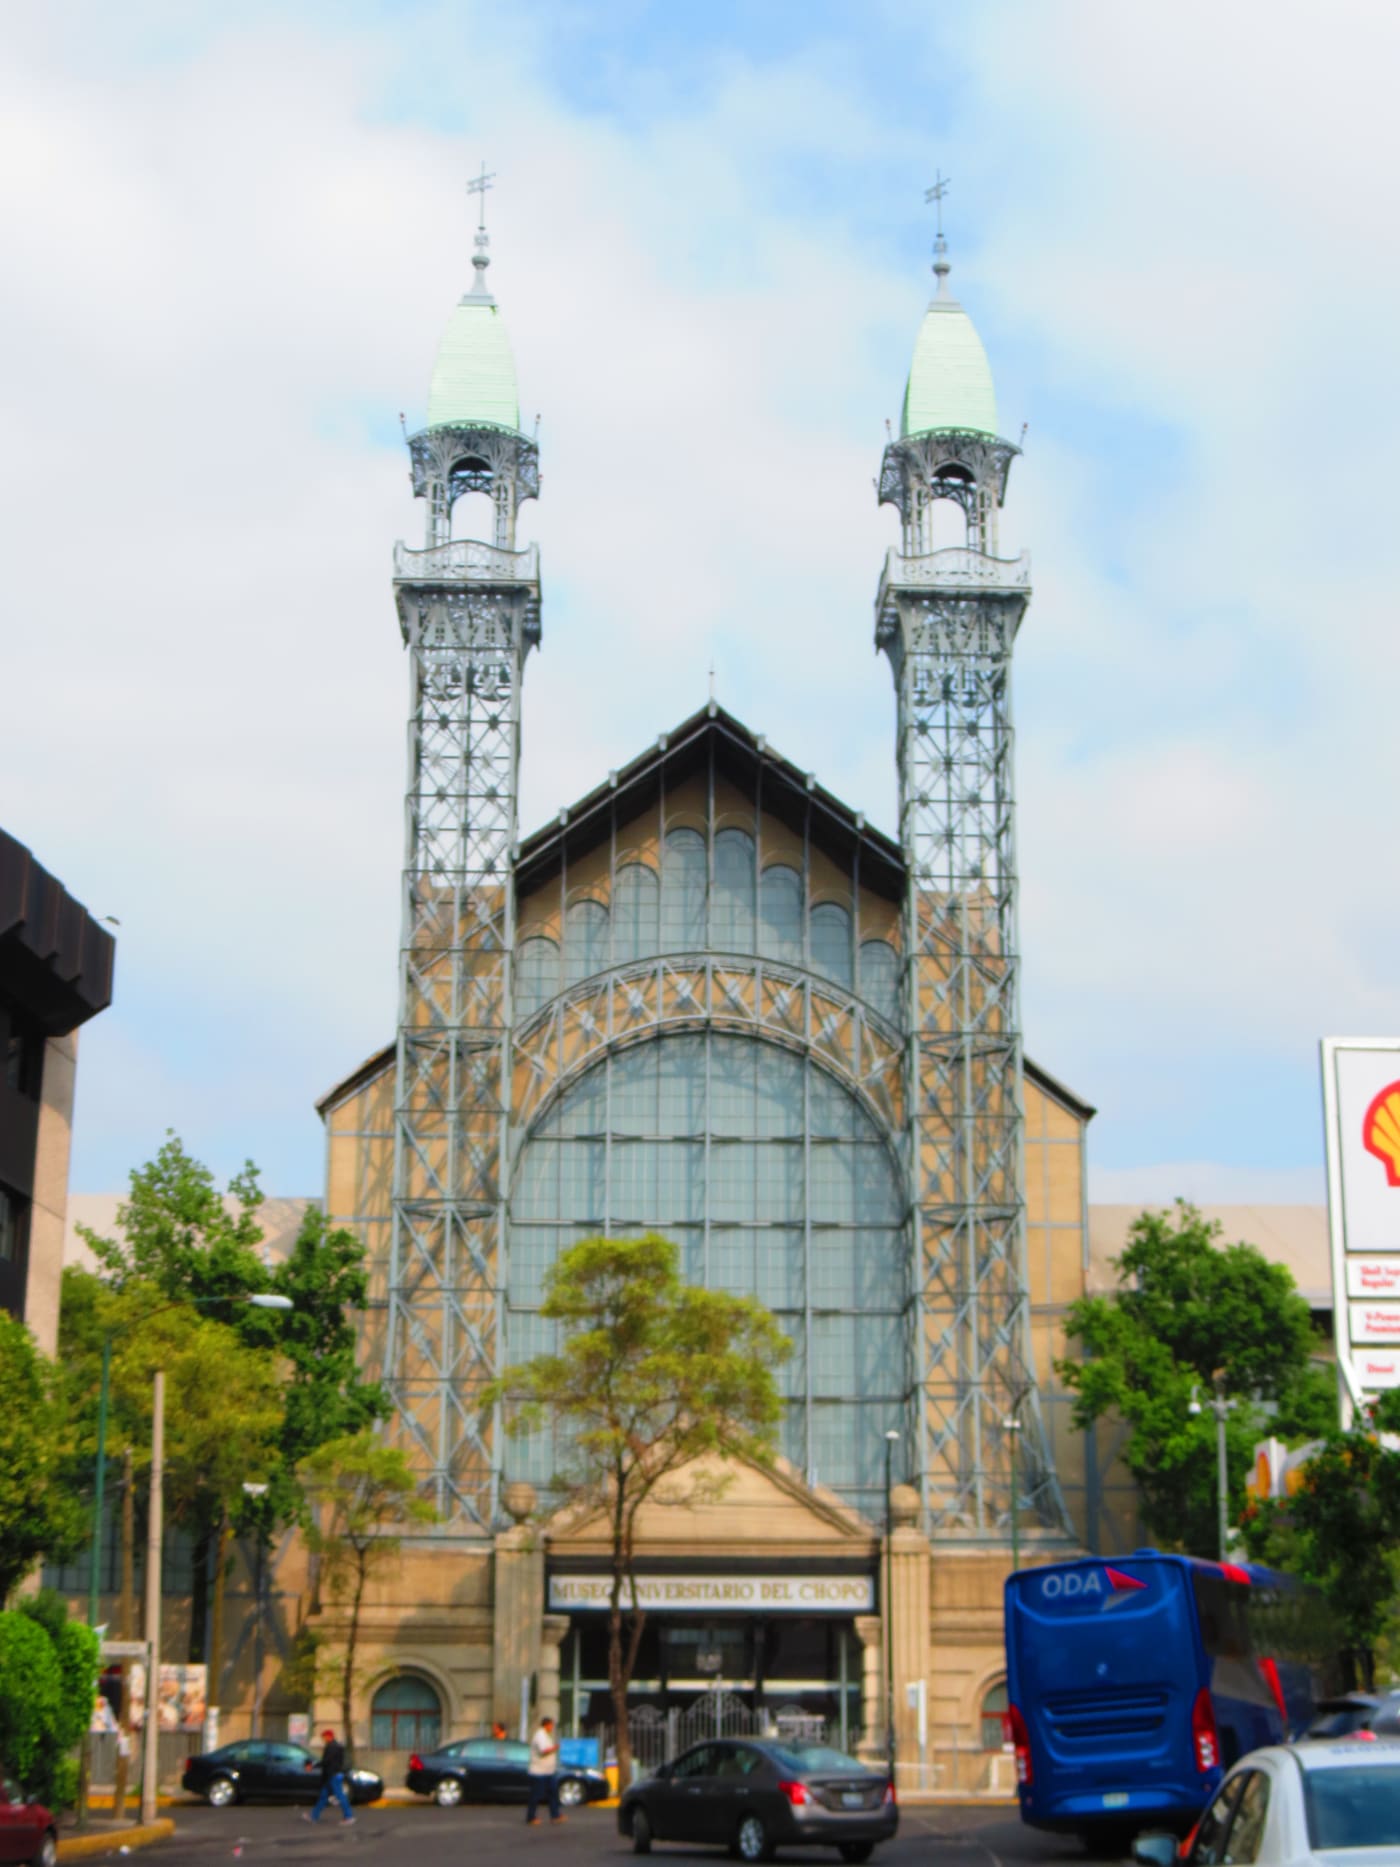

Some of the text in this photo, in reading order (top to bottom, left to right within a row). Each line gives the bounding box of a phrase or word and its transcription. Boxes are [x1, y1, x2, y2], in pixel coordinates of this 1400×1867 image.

[760, 1583, 793, 1600] DEL
[798, 1583, 868, 1600] CHOPO
[1042, 1571, 1102, 1598] ODA
